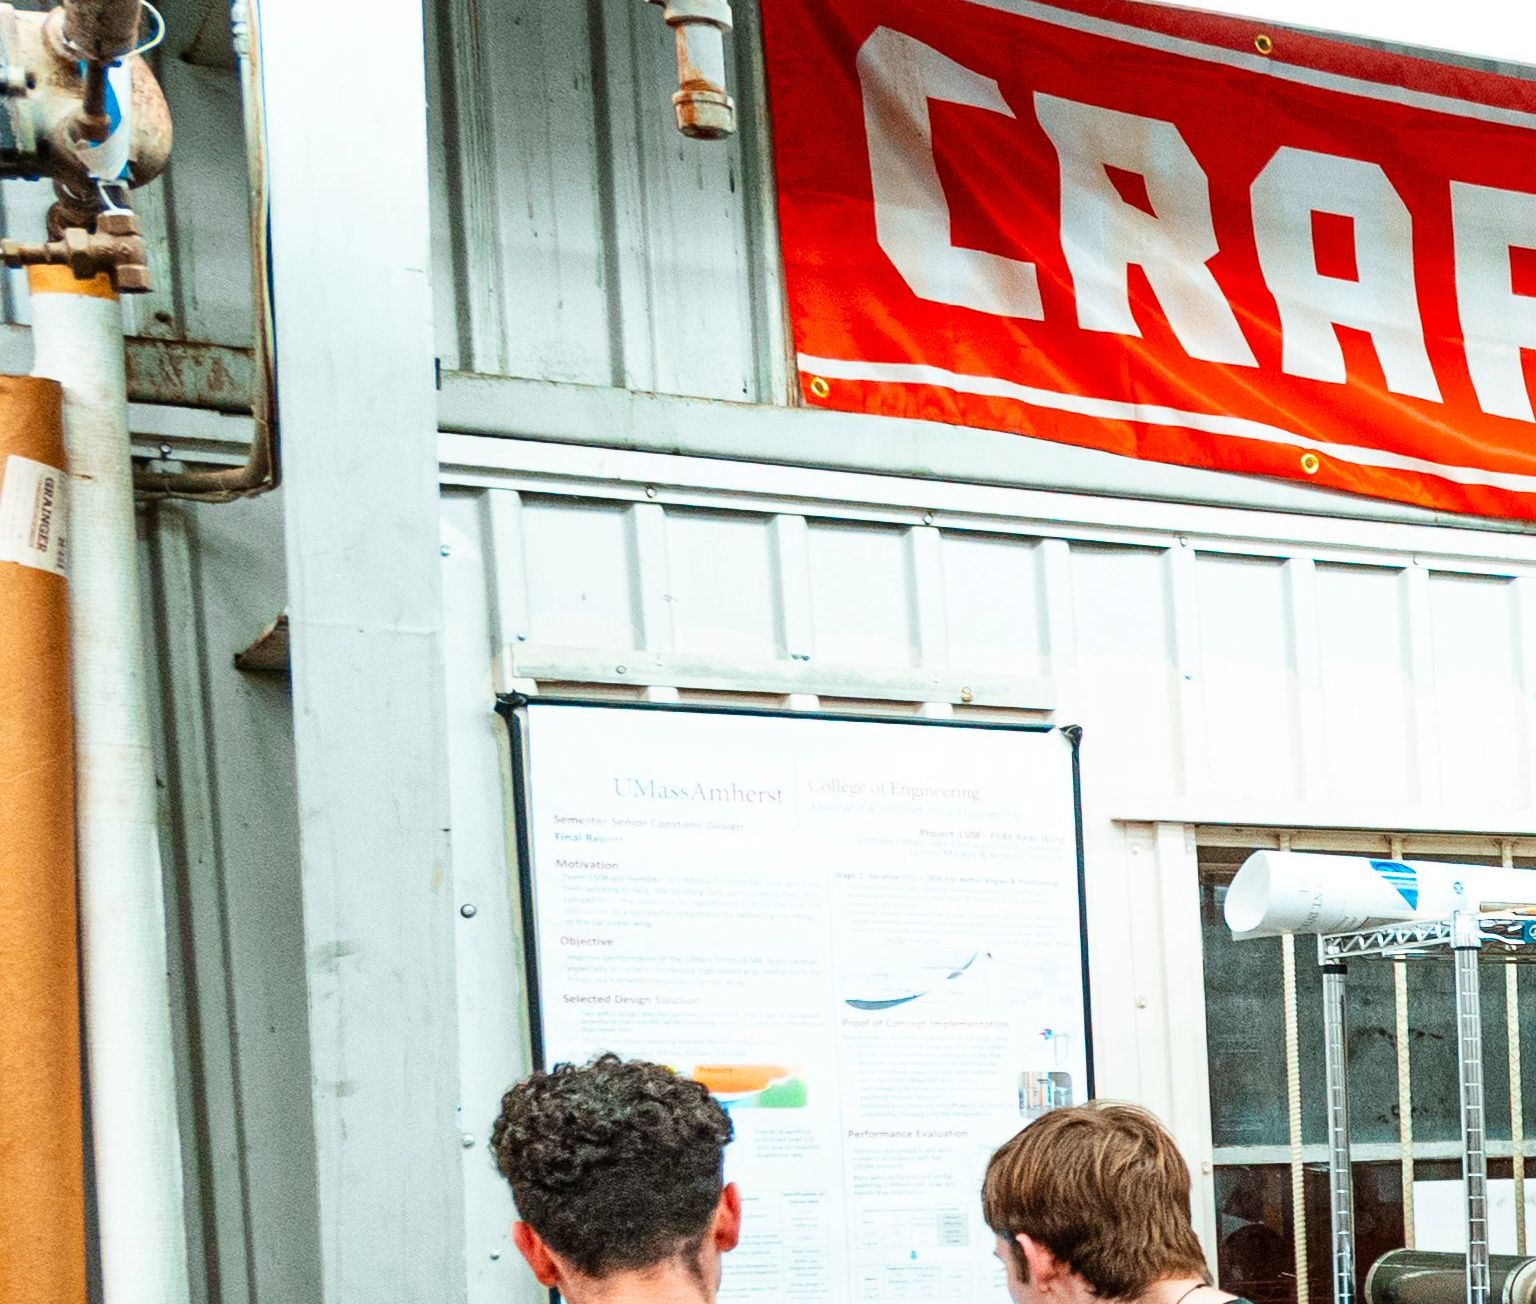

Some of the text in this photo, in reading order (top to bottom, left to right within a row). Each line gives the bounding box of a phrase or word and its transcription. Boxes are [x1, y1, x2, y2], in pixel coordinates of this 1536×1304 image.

[36, 476, 55, 553] GRAINGER
[556, 859, 619, 871] Motivation
[560, 936, 614, 949] Objective
[562, 994, 612, 1005] Selected
[848, 1128, 969, 1139] Performance Evaluation
